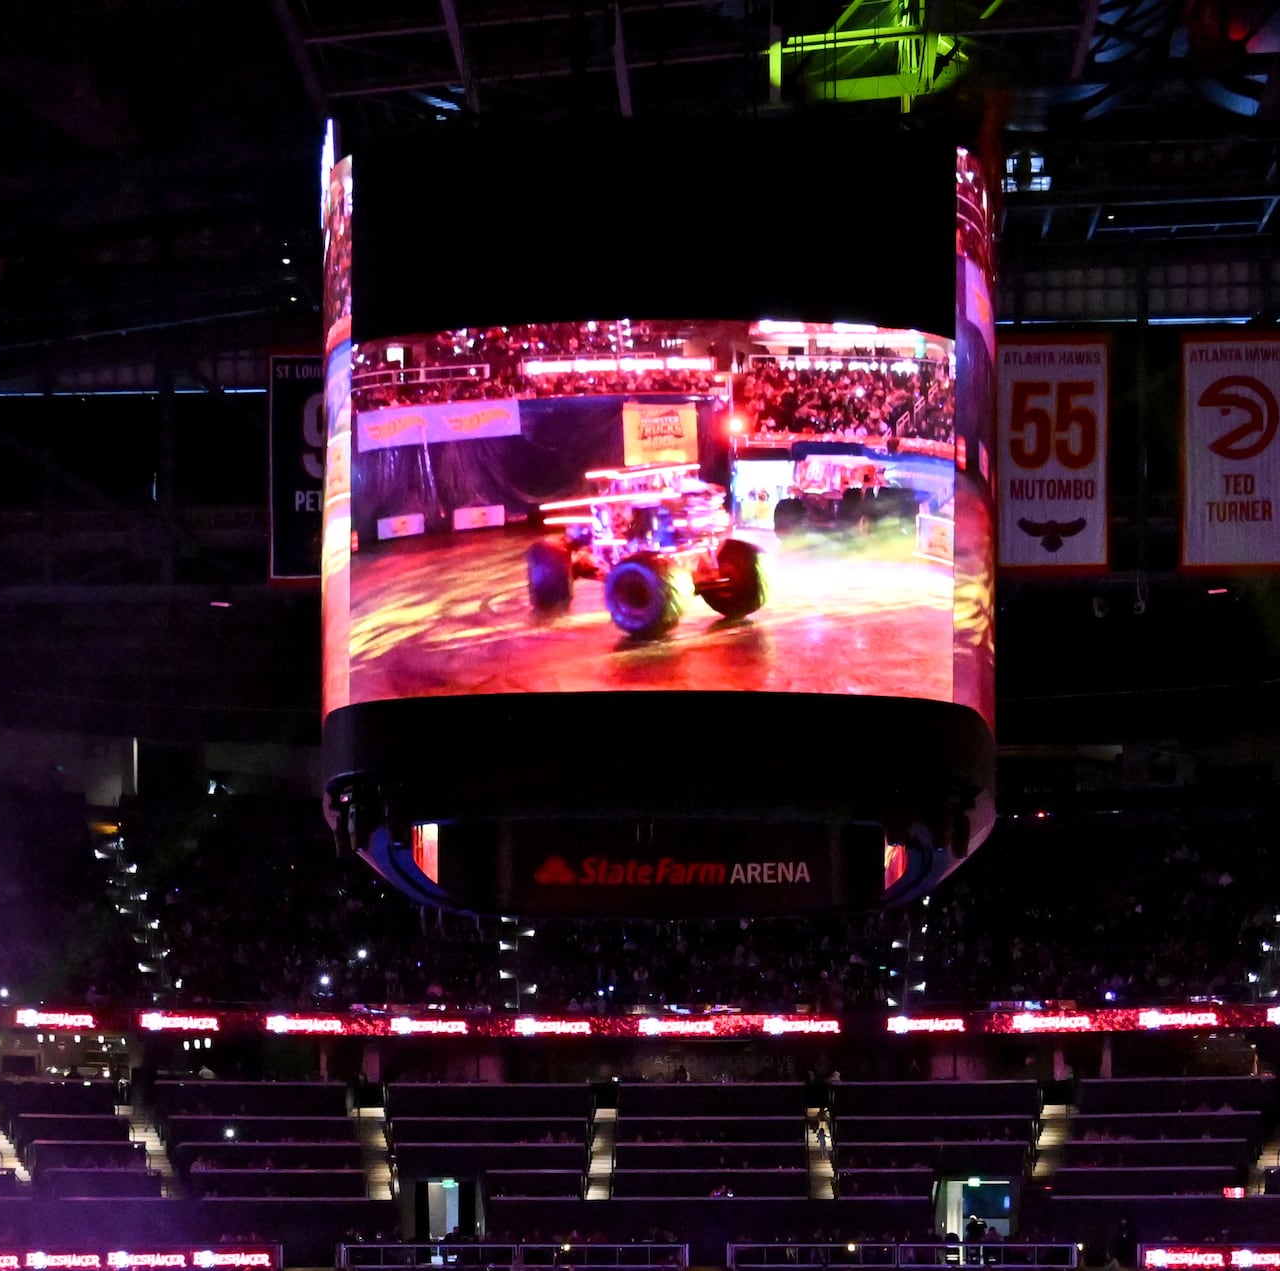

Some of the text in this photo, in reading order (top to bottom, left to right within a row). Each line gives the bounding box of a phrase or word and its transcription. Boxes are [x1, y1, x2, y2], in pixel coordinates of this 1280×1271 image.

[1004, 350, 1101, 365] ATLANTA HAWKS
[1190, 349, 1240, 363] ATLANTA
[1010, 381, 1096, 469] 55
[1010, 479, 1094, 500] MUTOMBO
[1223, 474, 1254, 494] TED
[1206, 501, 1273, 522] TURNER
[730, 861, 812, 884] ARENA
